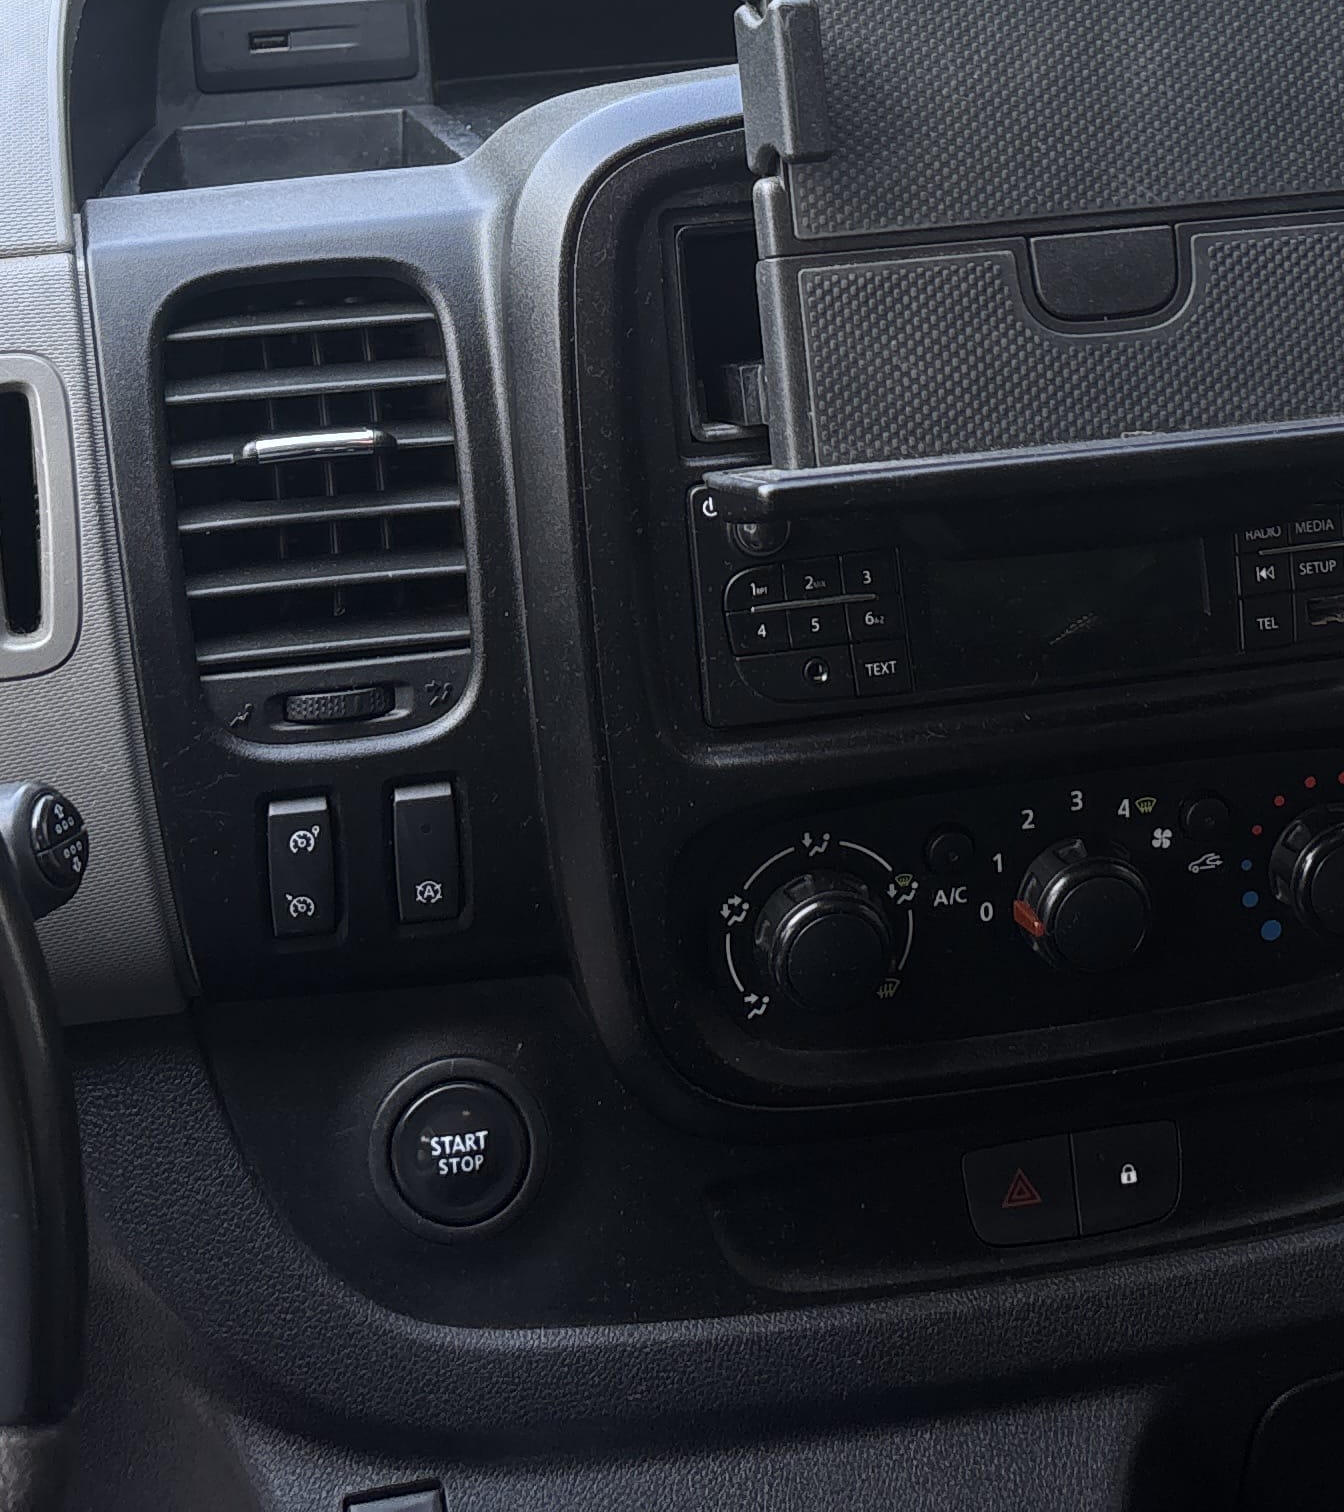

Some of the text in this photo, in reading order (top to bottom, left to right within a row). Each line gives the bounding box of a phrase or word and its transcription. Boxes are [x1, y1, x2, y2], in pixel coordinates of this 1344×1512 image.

[1245, 525, 1282, 541] RADIO
[1295, 518, 1335, 535] MEDIA
[1299, 559, 1338, 576] SETUP
[804, 575, 814, 590] 2
[862, 570, 872, 585] 3
[811, 617, 821, 632] 5
[865, 611, 875, 626] 6
[1256, 616, 1280, 631] TEL
[757, 624, 767, 638] 4
[865, 660, 898, 678] TEXT
[1070, 790, 1084, 812] 3
[1117, 798, 1131, 819] 4
[1021, 809, 1036, 830] 2
[992, 852, 1004, 873] 1
[933, 885, 969, 908] A/C
[979, 901, 995, 923] 0
[430, 1130, 489, 1157] START
[438, 1154, 485, 1175] STOP
